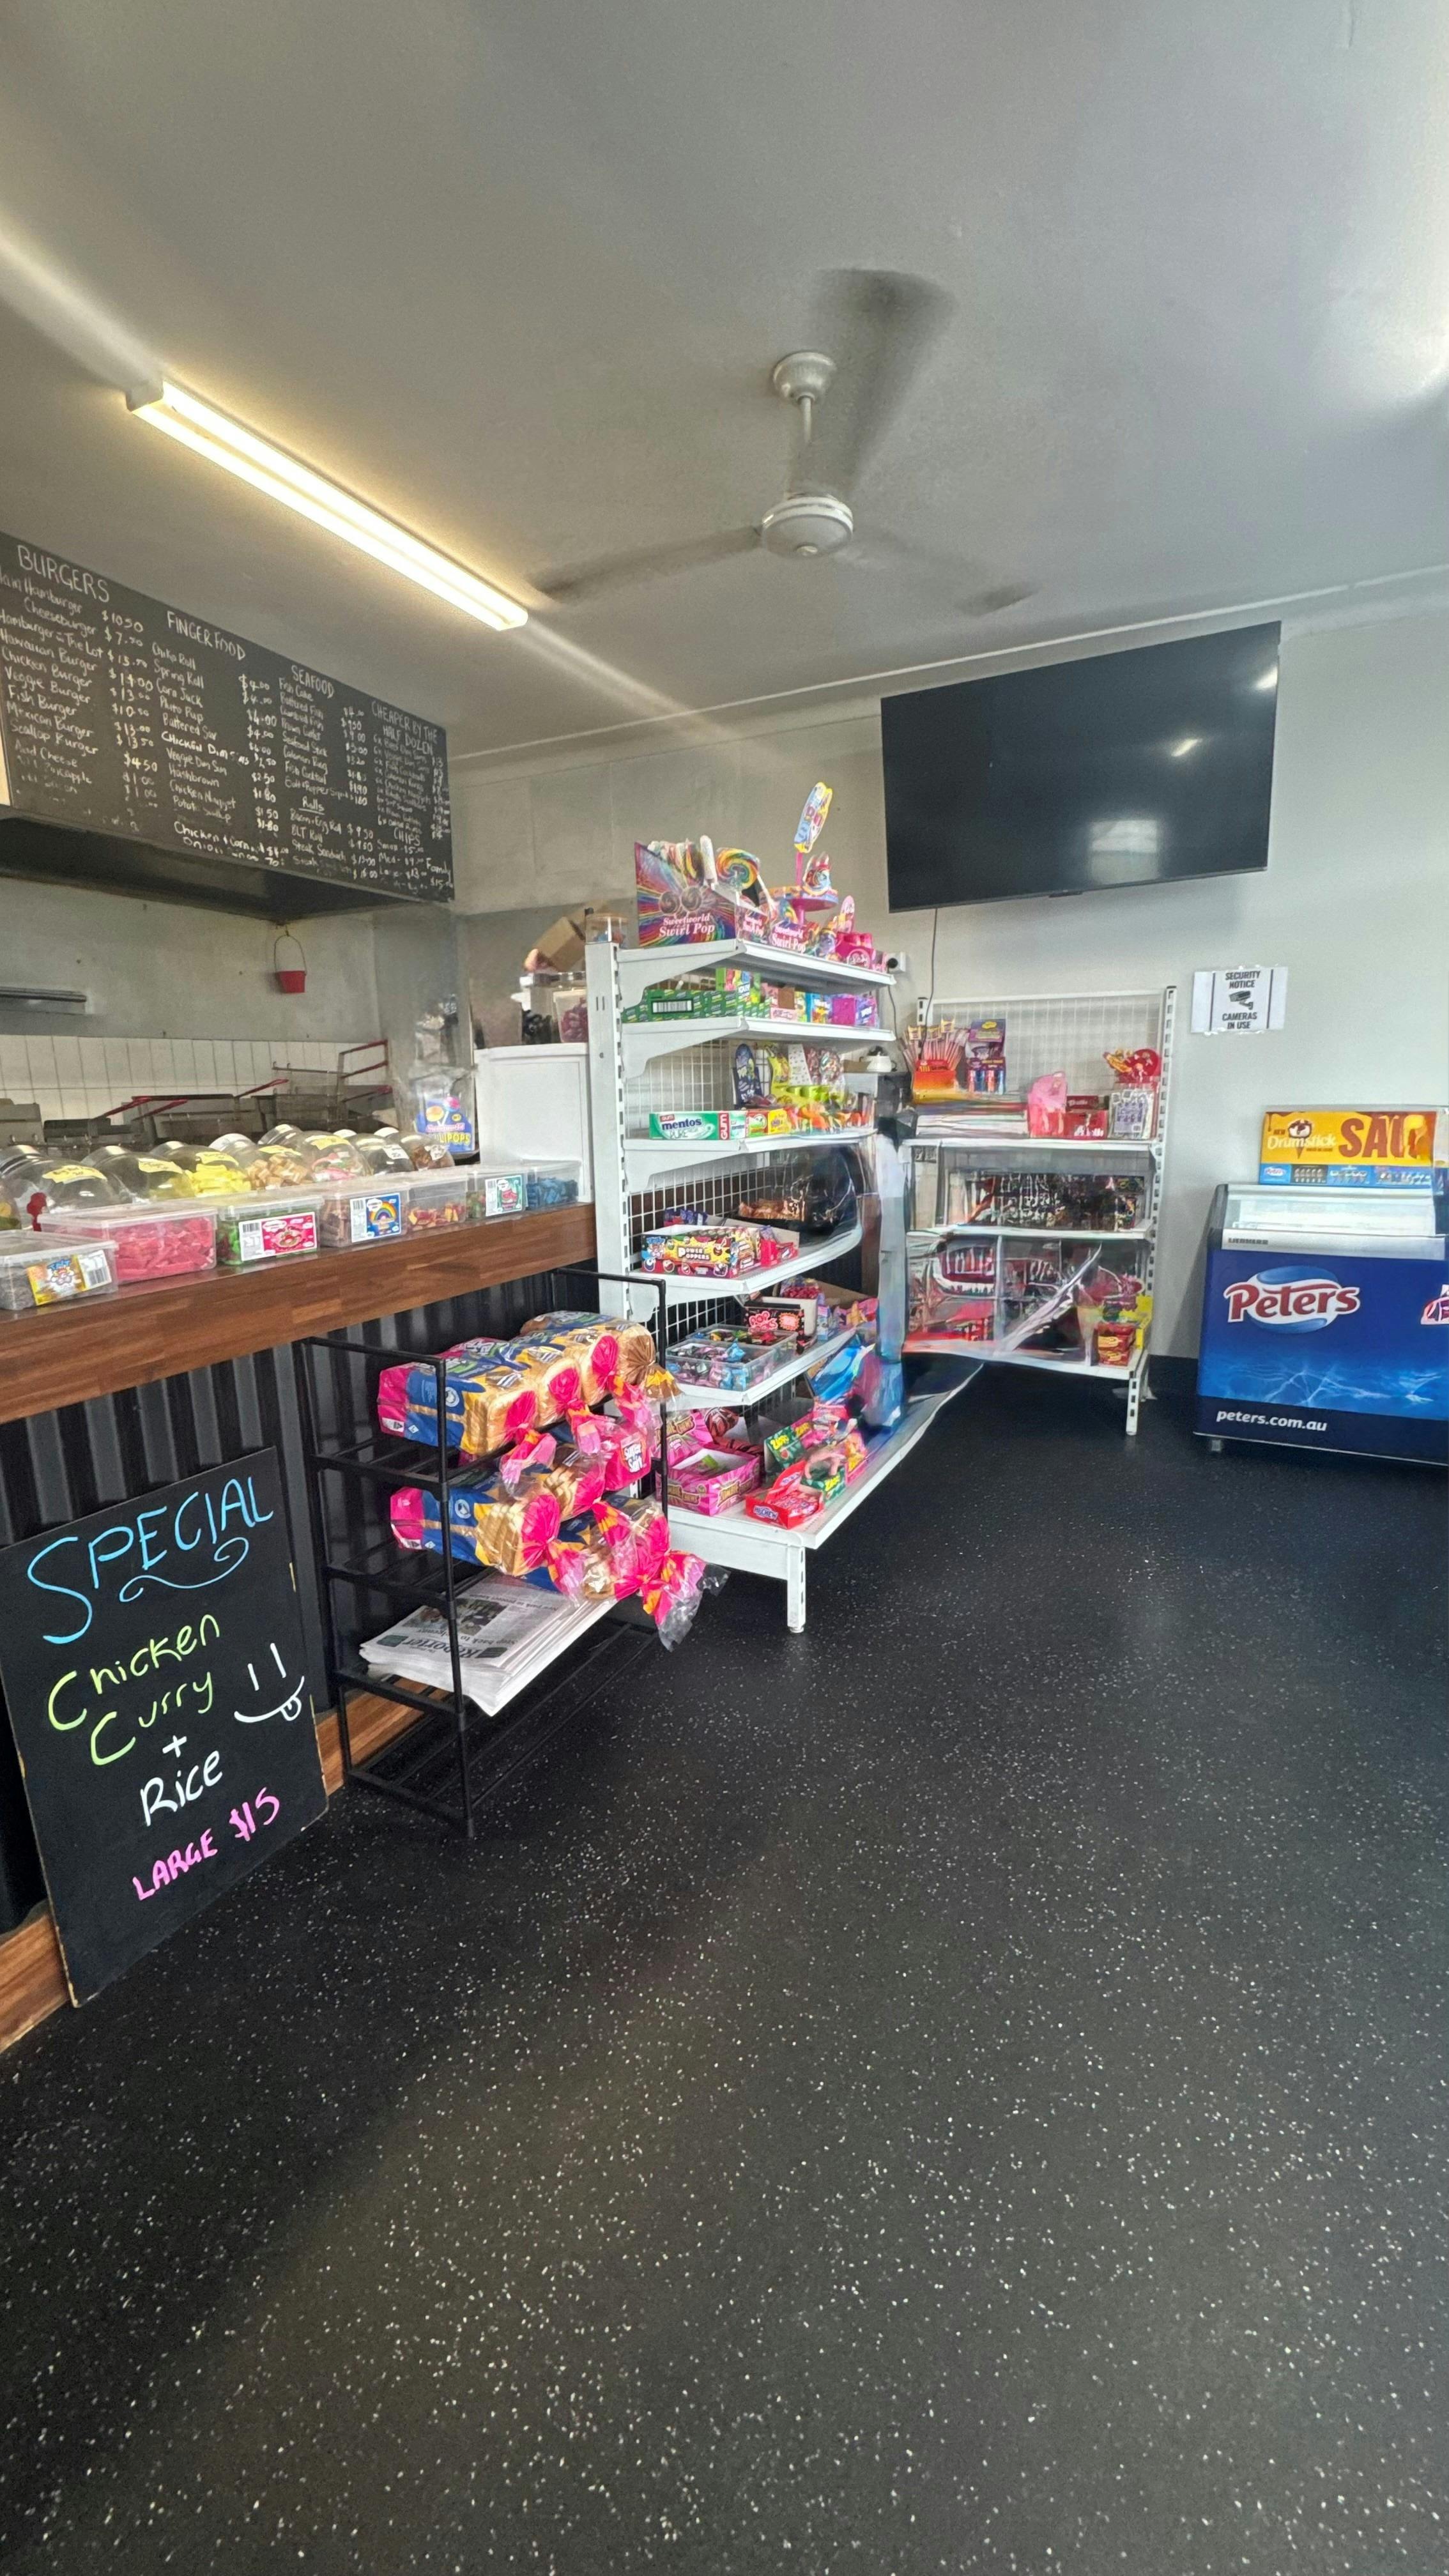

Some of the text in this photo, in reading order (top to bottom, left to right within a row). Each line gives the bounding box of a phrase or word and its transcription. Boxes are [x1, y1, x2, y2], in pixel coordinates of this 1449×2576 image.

[18, 545, 109, 602] BURGERS
[167, 610, 213, 648] FINGER
[59, 648, 97, 677] Burger
[86, 641, 103, 659] Lot
[51, 663, 93, 691] Burger
[291, 664, 335, 699] SEAFOOD
[38, 694, 77, 719] Burger
[50, 681, 91, 706] Burger
[372, 701, 410, 731] CHEAPER
[394, 827, 421, 847] CHIPS
[659, 923, 716, 938] Swirl Pop
[663, 913, 710, 926] Sweetworld
[1225, 970, 1261, 980] SECURITY
[1229, 979, 1255, 988] NOTICE
[1222, 1012, 1257, 1021] CAMERAS
[662, 1114, 728, 1140] mentos GUM
[1267, 1133, 1337, 1150] Drumstick
[1226, 1283, 1359, 1321] Peters
[1216, 1409, 1328, 1432] peters.com.au
[26, 1476, 274, 1644] SPECIAL
[48, 1614, 221, 1731] Chicken
[89, 1671, 215, 1766] Curry
[140, 1751, 224, 1827] Rice
[132, 1787, 280, 1901] LARGE $15
